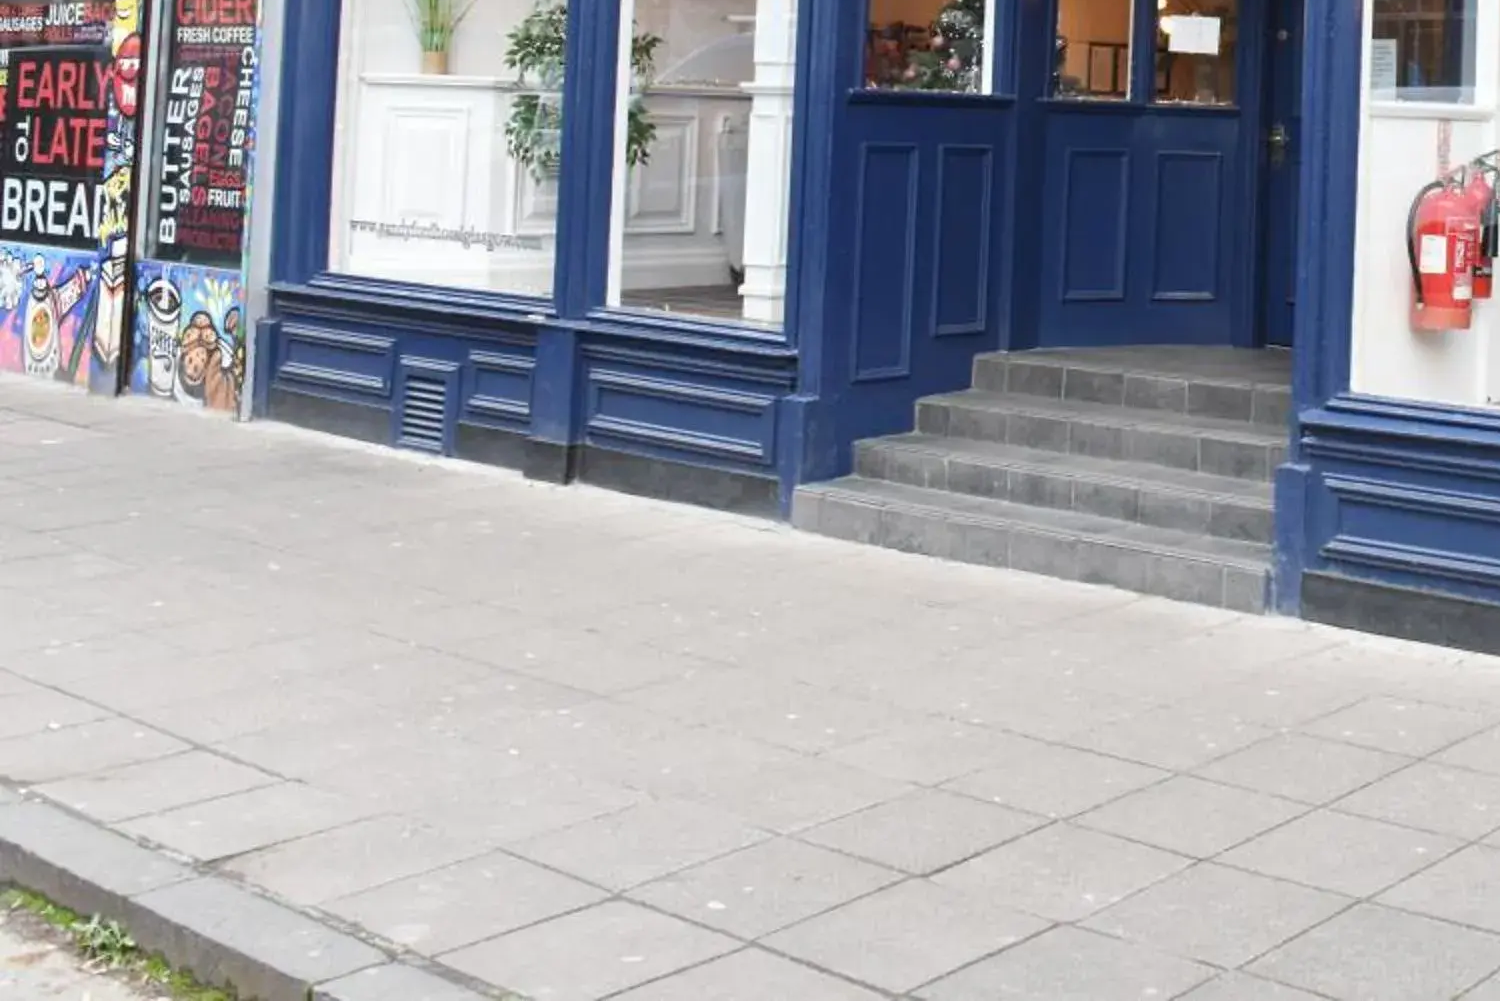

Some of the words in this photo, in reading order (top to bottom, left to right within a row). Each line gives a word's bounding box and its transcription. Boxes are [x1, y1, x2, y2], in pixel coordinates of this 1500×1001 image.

[45, 2, 85, 26] JUICE
[177, 27, 211, 44] FRESH
[212, 26, 254, 44] COFFEE
[17, 60, 113, 111] EARLY
[228, 46, 255, 167] CHEESE
[15, 115, 31, 164] TO
[32, 116, 106, 168] LATE
[158, 66, 193, 245] BUTTER
[179, 66, 205, 204] SAUSAGES
[191, 66, 221, 208] BAGELS
[207, 188, 242, 209] FRUIT
